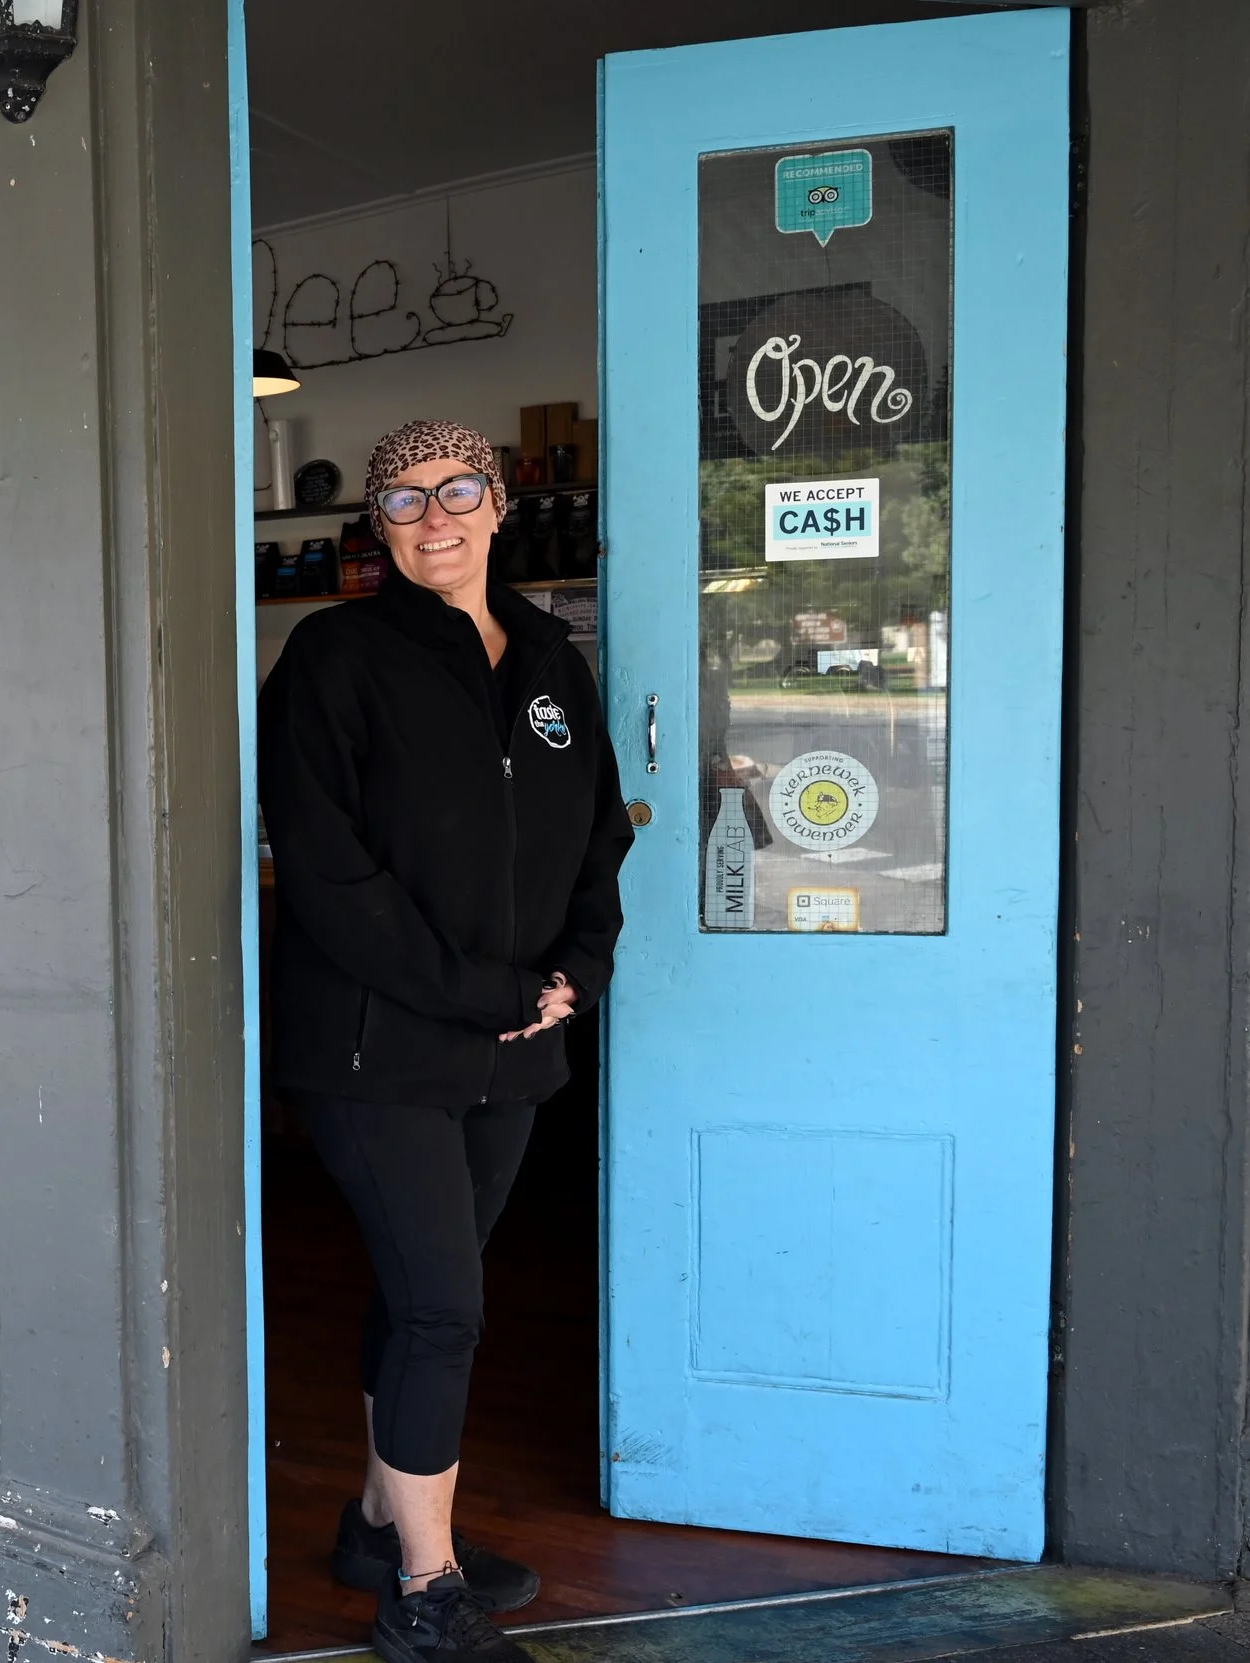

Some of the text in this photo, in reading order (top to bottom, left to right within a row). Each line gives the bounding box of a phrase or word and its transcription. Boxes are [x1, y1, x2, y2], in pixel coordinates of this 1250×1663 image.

[783, 163, 864, 179] RECOMMENDED
[745, 334, 913, 450] Open
[780, 487, 865, 502] WE ACCEPT
[779, 507, 865, 536] CA$H
[804, 755, 844, 763] SUPPORTING
[716, 846, 725, 893] PROUDLY SERVING
[725, 826, 746, 913] MILKLAB
[813, 896, 851, 908] Square
